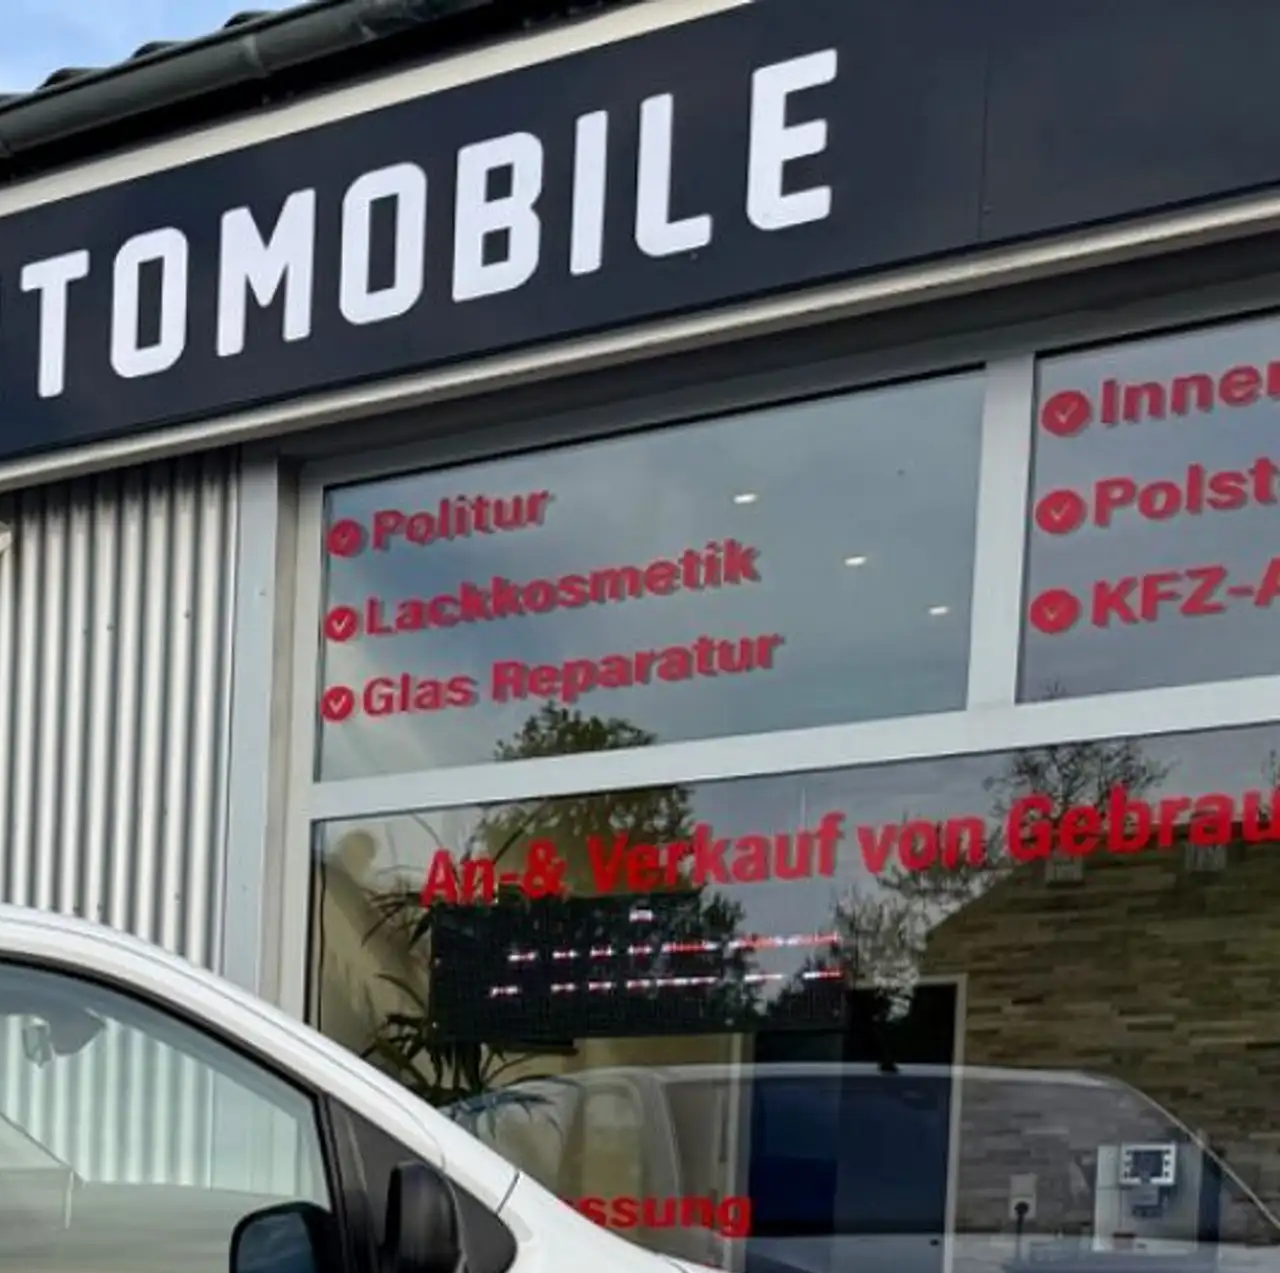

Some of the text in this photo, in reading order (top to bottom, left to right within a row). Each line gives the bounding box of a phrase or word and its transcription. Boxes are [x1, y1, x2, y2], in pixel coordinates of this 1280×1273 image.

[372, 489, 553, 551] Politur
[1094, 456, 1280, 527] Polst
[365, 538, 763, 636] Lackkosmetik
[362, 633, 785, 718] Glas Reparatur
[587, 813, 844, 893] Verkauf
[857, 814, 988, 874] von
[1007, 782, 1280, 861] Gebrau
[560, 1194, 753, 1238] ssung
